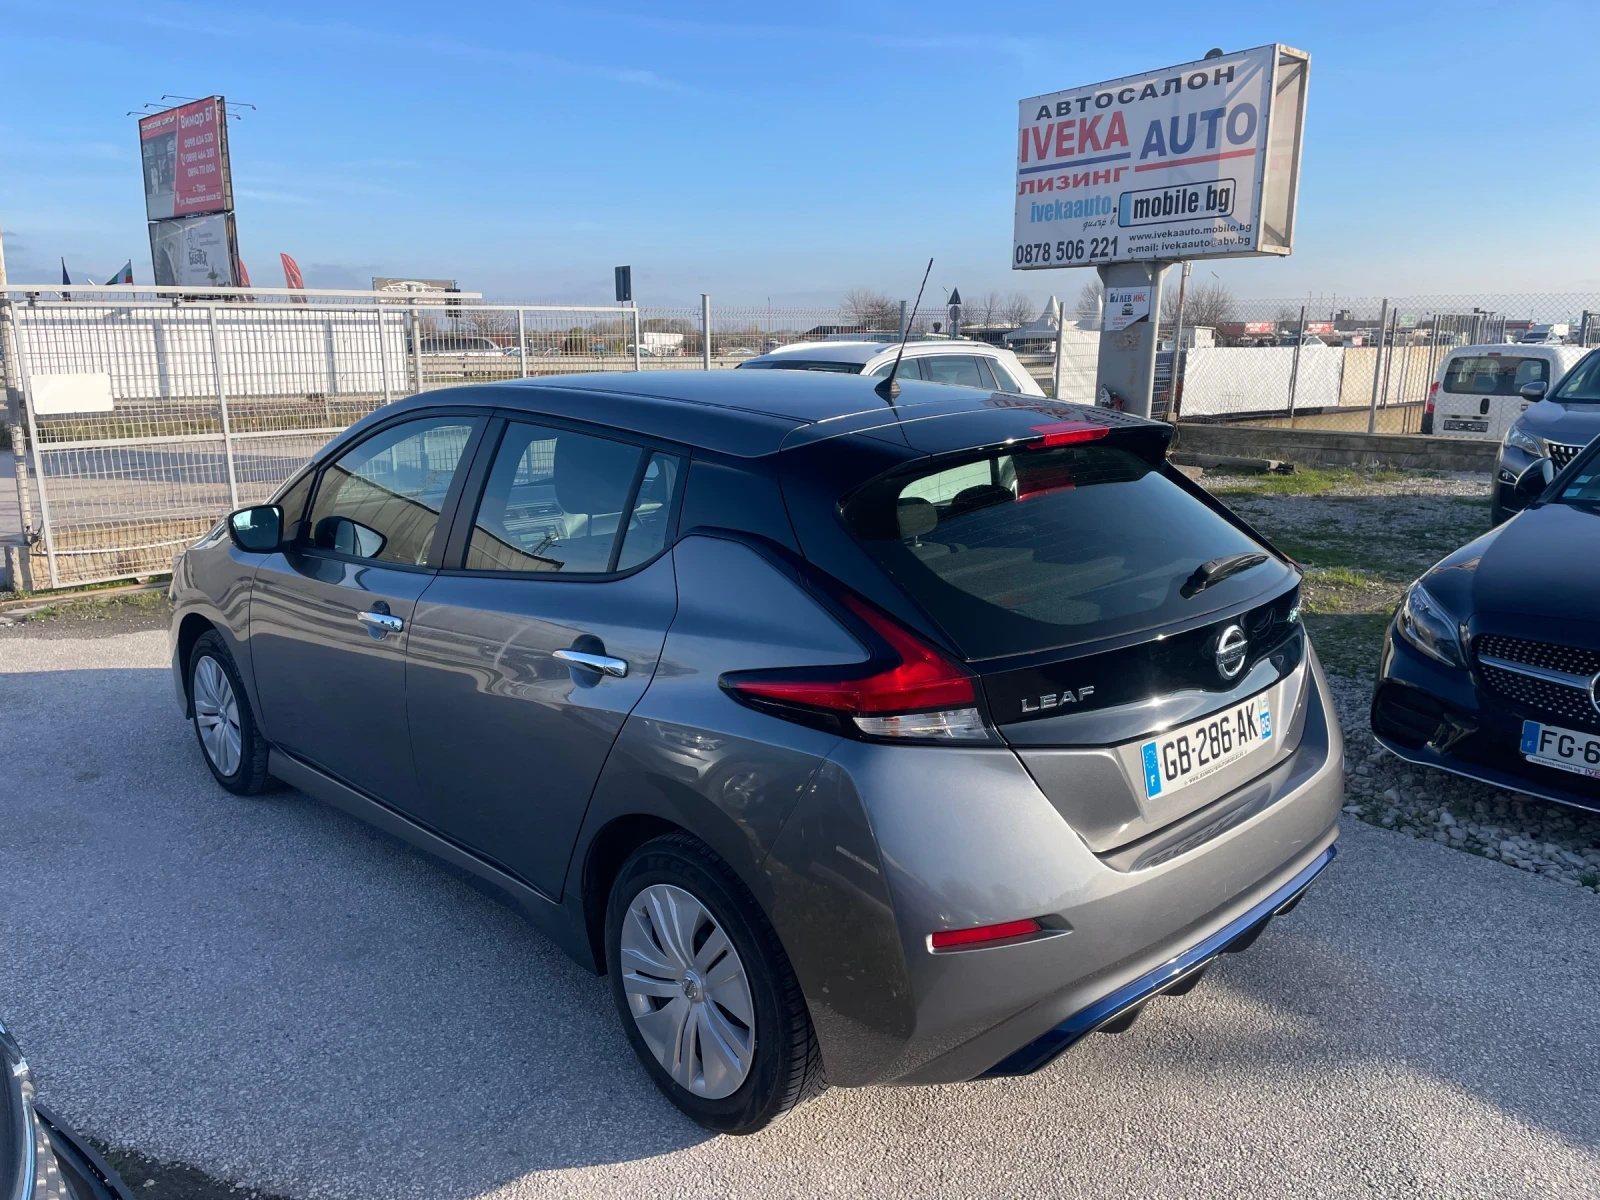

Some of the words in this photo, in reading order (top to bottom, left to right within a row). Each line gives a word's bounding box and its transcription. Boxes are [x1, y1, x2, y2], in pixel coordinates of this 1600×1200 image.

[1035, 65, 1236, 121] АВТОСАЛОН
[180, 111, 203, 130] Вимар
[1020, 110, 1130, 164] IVEKA
[1139, 102, 1258, 161] AUTO
[1018, 166, 1130, 196] ЛИЗИНГ
[1133, 183, 1231, 220] mobile.bg
[1127, 241, 1160, 254] e-mail:
[1161, 235, 1251, 253] ivekaauto@abv.bg
[1128, 222, 1252, 242] www.ivekaauto.mobile.bg
[1015, 239, 1052, 265] 0878
[1056, 238, 1085, 262] 506
[1089, 234, 1119, 260] 221
[1020, 685, 1095, 713] LEAF
[1261, 714, 1271, 734] 85
[1161, 702, 1259, 782] GB-286-AK
[1150, 775, 1156, 787] F
